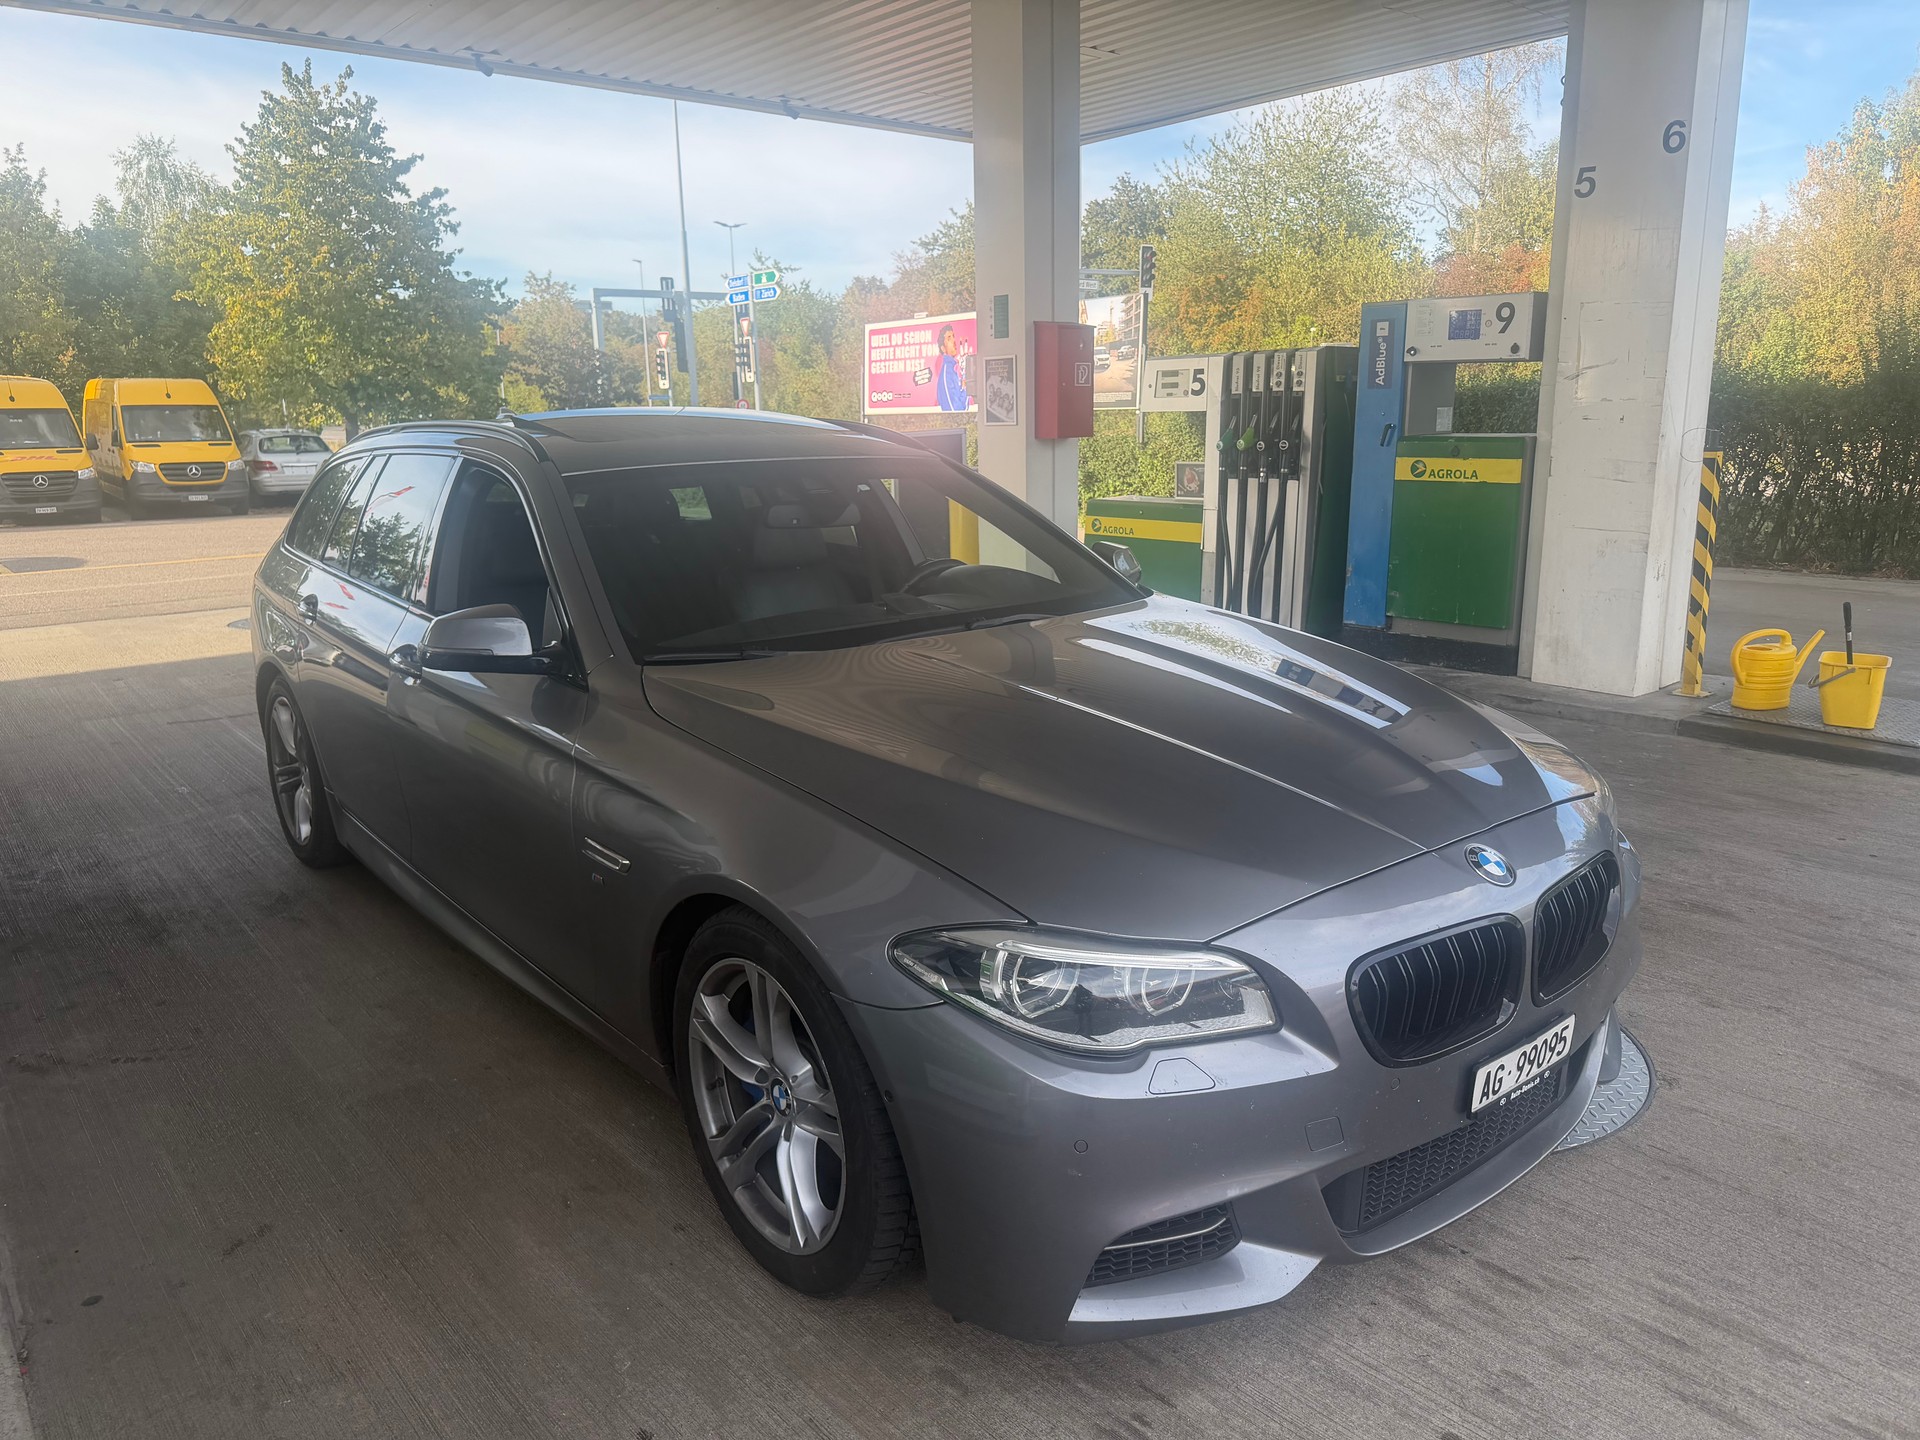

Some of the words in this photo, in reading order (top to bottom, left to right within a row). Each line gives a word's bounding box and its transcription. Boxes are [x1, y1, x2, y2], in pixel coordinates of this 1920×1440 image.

[1662, 119, 1687, 154] 6
[1574, 165, 1597, 199] 5
[1495, 301, 1516, 335] 9
[870, 333, 891, 348] WEIL
[891, 332, 903, 346] DU
[903, 330, 933, 345] SCHON
[871, 346, 894, 361] HEUTE
[895, 344, 921, 359] NICHT
[921, 343, 940, 357] VON
[871, 360, 905, 375] GESTERN
[1190, 368, 1206, 397] 5
[1428, 468, 1479, 480] AGROLA
[1102, 525, 1135, 536] AGROLA
